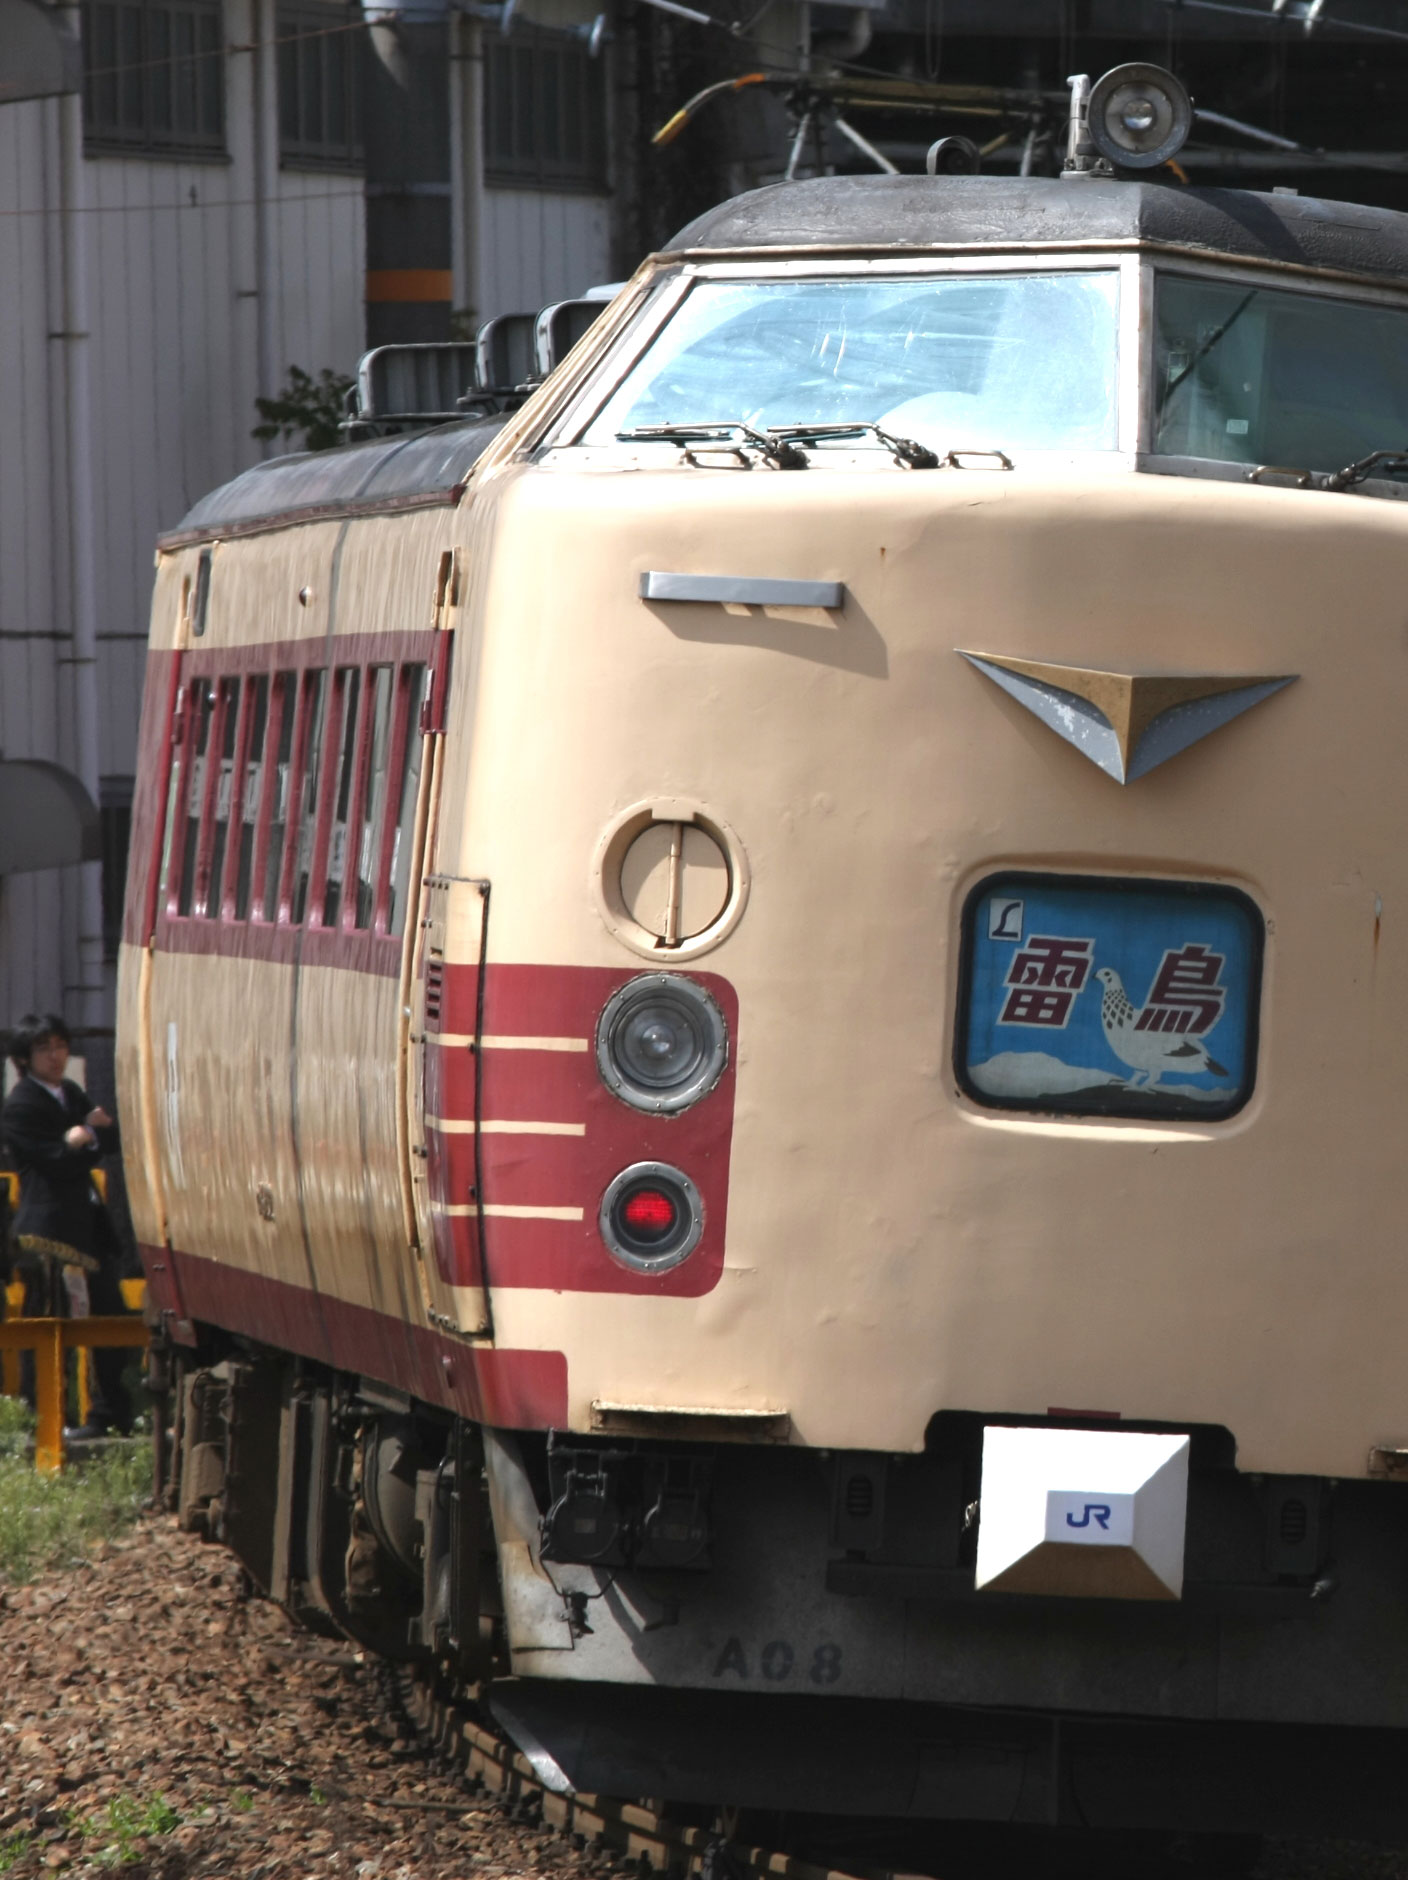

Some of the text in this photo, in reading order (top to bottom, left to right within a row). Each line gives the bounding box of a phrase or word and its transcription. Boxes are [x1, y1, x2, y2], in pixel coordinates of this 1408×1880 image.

[999, 935, 1226, 1035] 雷鳥
[1066, 1504, 1111, 1530] JR
[711, 1637, 843, 1685] A08
